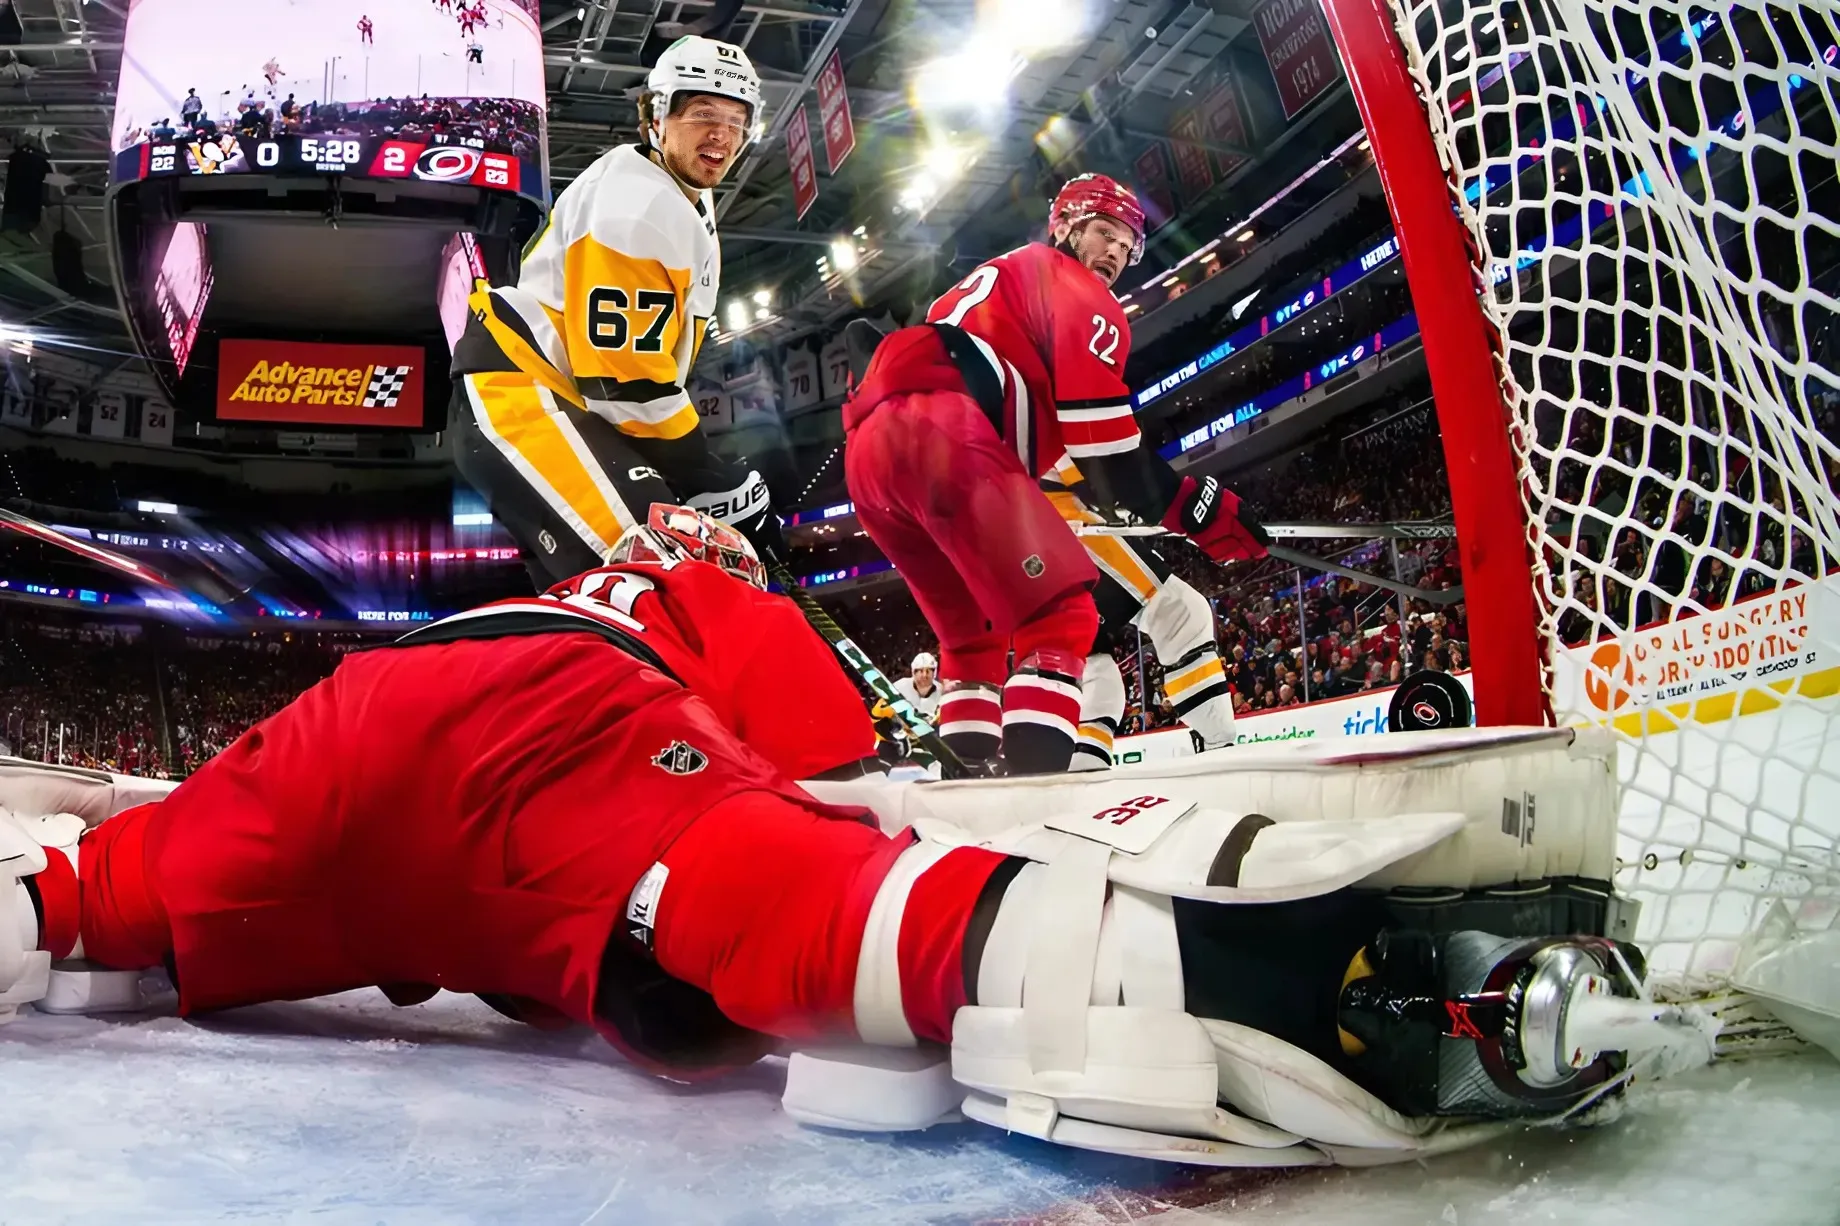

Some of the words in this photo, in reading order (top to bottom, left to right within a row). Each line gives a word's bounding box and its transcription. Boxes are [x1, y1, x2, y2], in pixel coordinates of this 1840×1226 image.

[256, 142, 280, 167] 0
[301, 138, 360, 164] 5:28
[383, 147, 406, 172] 2
[587, 285, 676, 353] 67
[1088, 314, 1120, 366] 22
[246, 359, 363, 386] Advance
[228, 381, 291, 403] Auto
[291, 384, 357, 406] Parts
[790, 374, 810, 398] 70
[632, 902, 649, 922] XL
